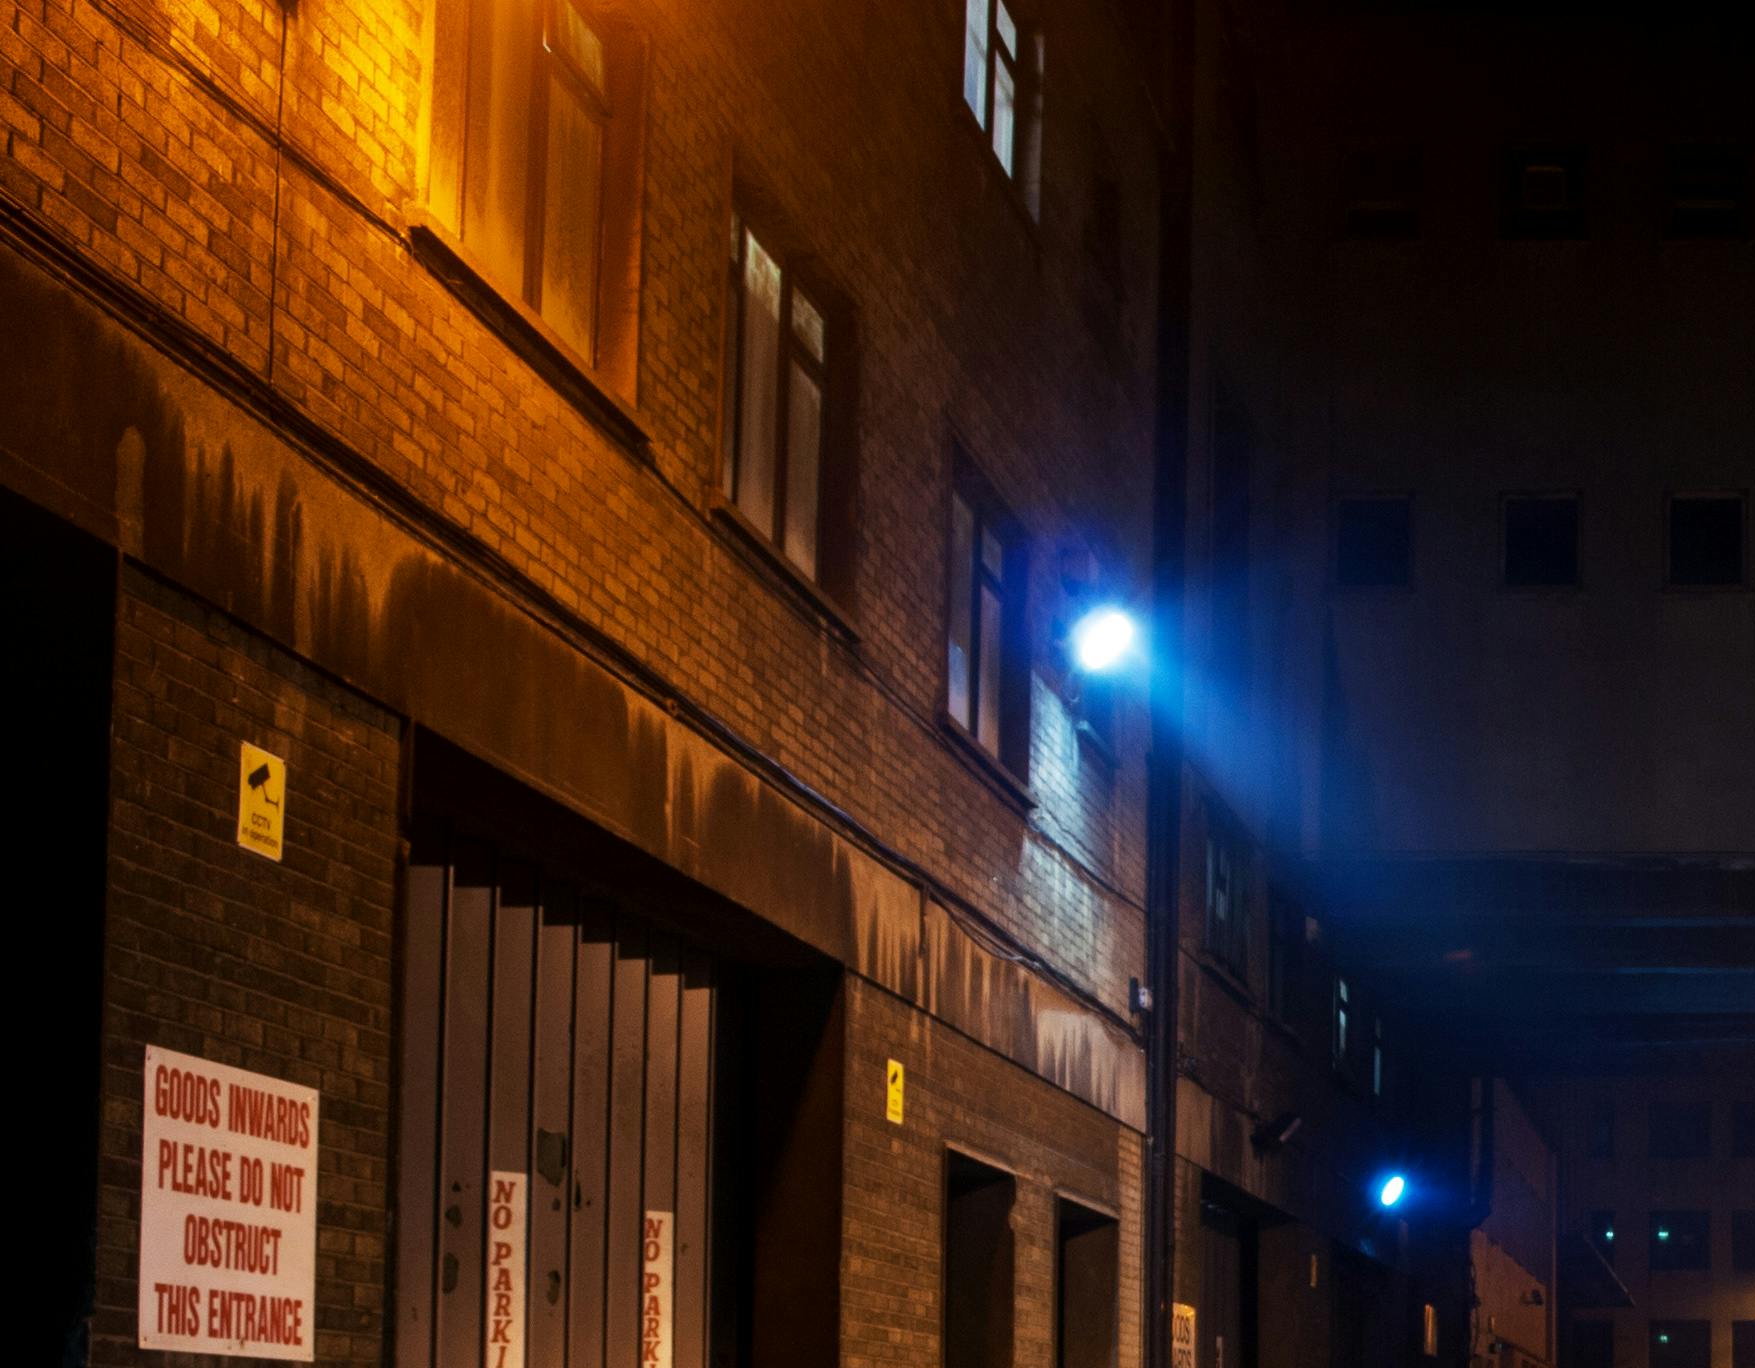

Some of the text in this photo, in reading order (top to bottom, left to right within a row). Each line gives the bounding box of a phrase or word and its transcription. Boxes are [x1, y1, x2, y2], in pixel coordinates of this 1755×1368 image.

[155, 1064, 310, 1149] GOODS INWARDS
[159, 1139, 305, 1214] PLEASE DO NOT
[493, 1180, 516, 1230] NO
[184, 1214, 282, 1276] OBSTRUCT
[643, 1218, 663, 1263] NO
[155, 1283, 303, 1347] THIS ENTRANCE
